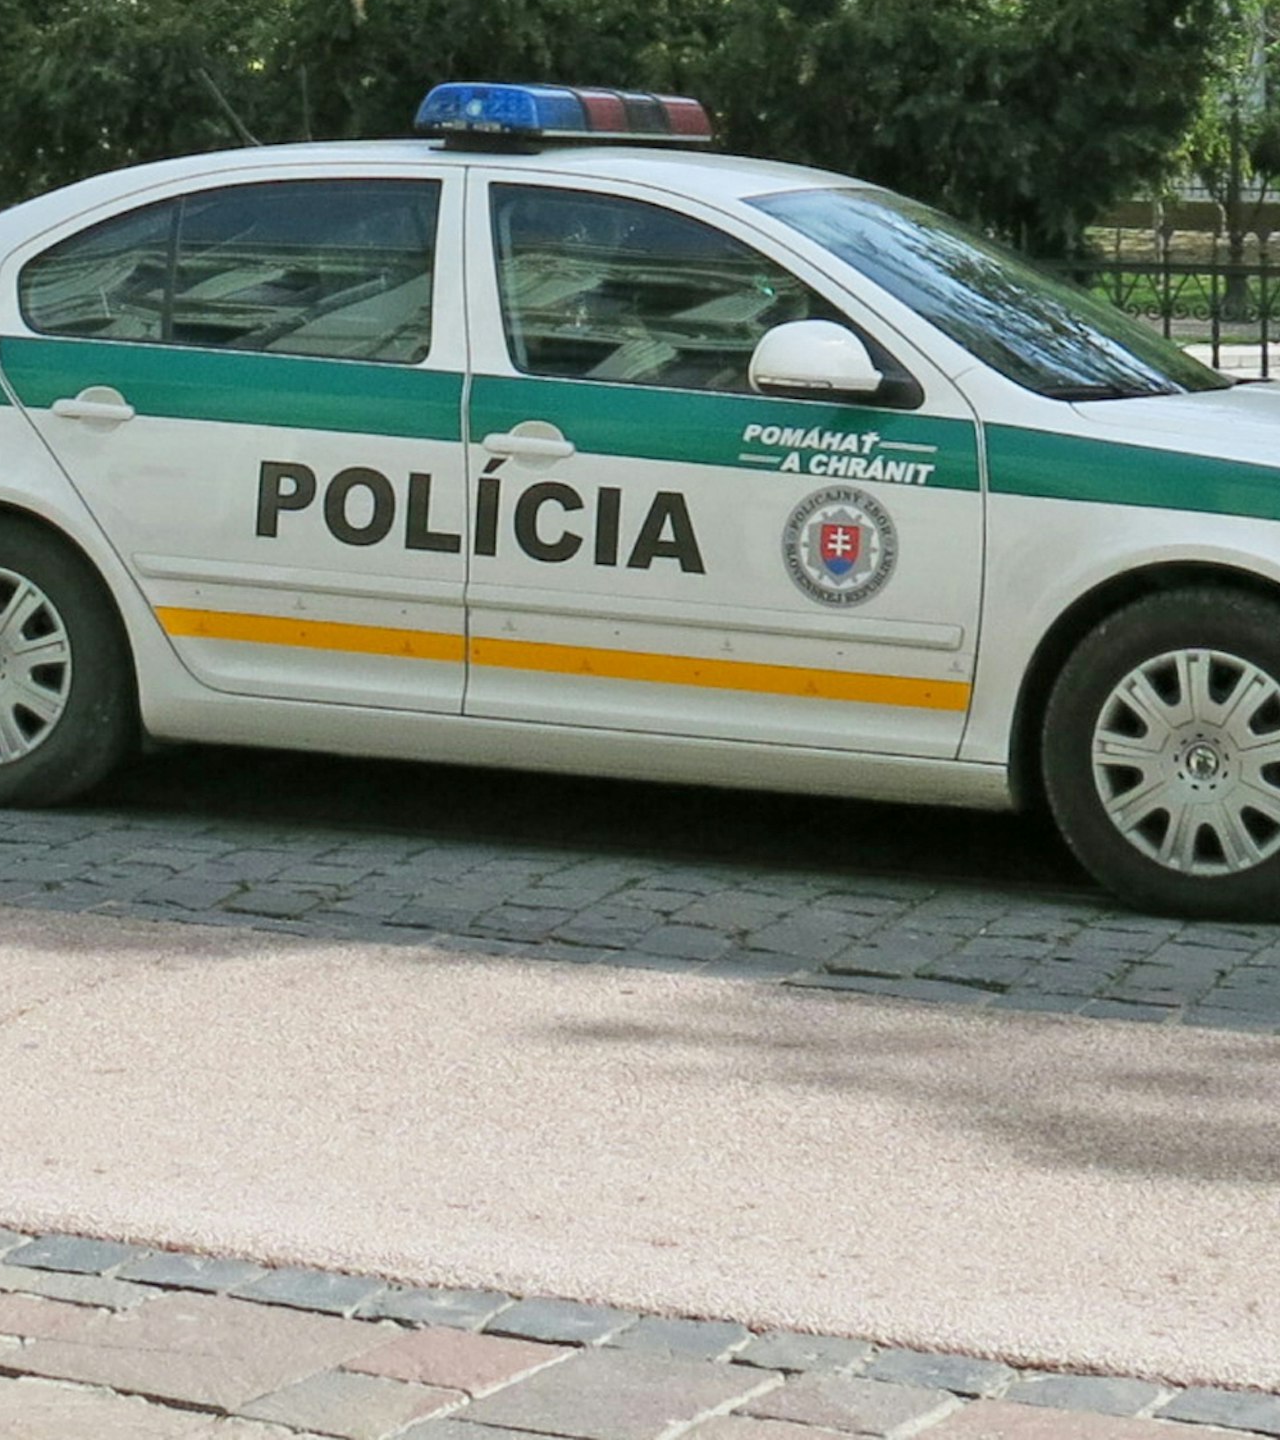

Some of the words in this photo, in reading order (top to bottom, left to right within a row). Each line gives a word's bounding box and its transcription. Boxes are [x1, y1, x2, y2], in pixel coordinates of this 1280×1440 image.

[743, 424, 880, 455] POMÁHAŤ
[780, 451, 801, 473] A
[809, 455, 935, 484] CHRÁNIT
[256, 457, 706, 574] POLÍCIA
